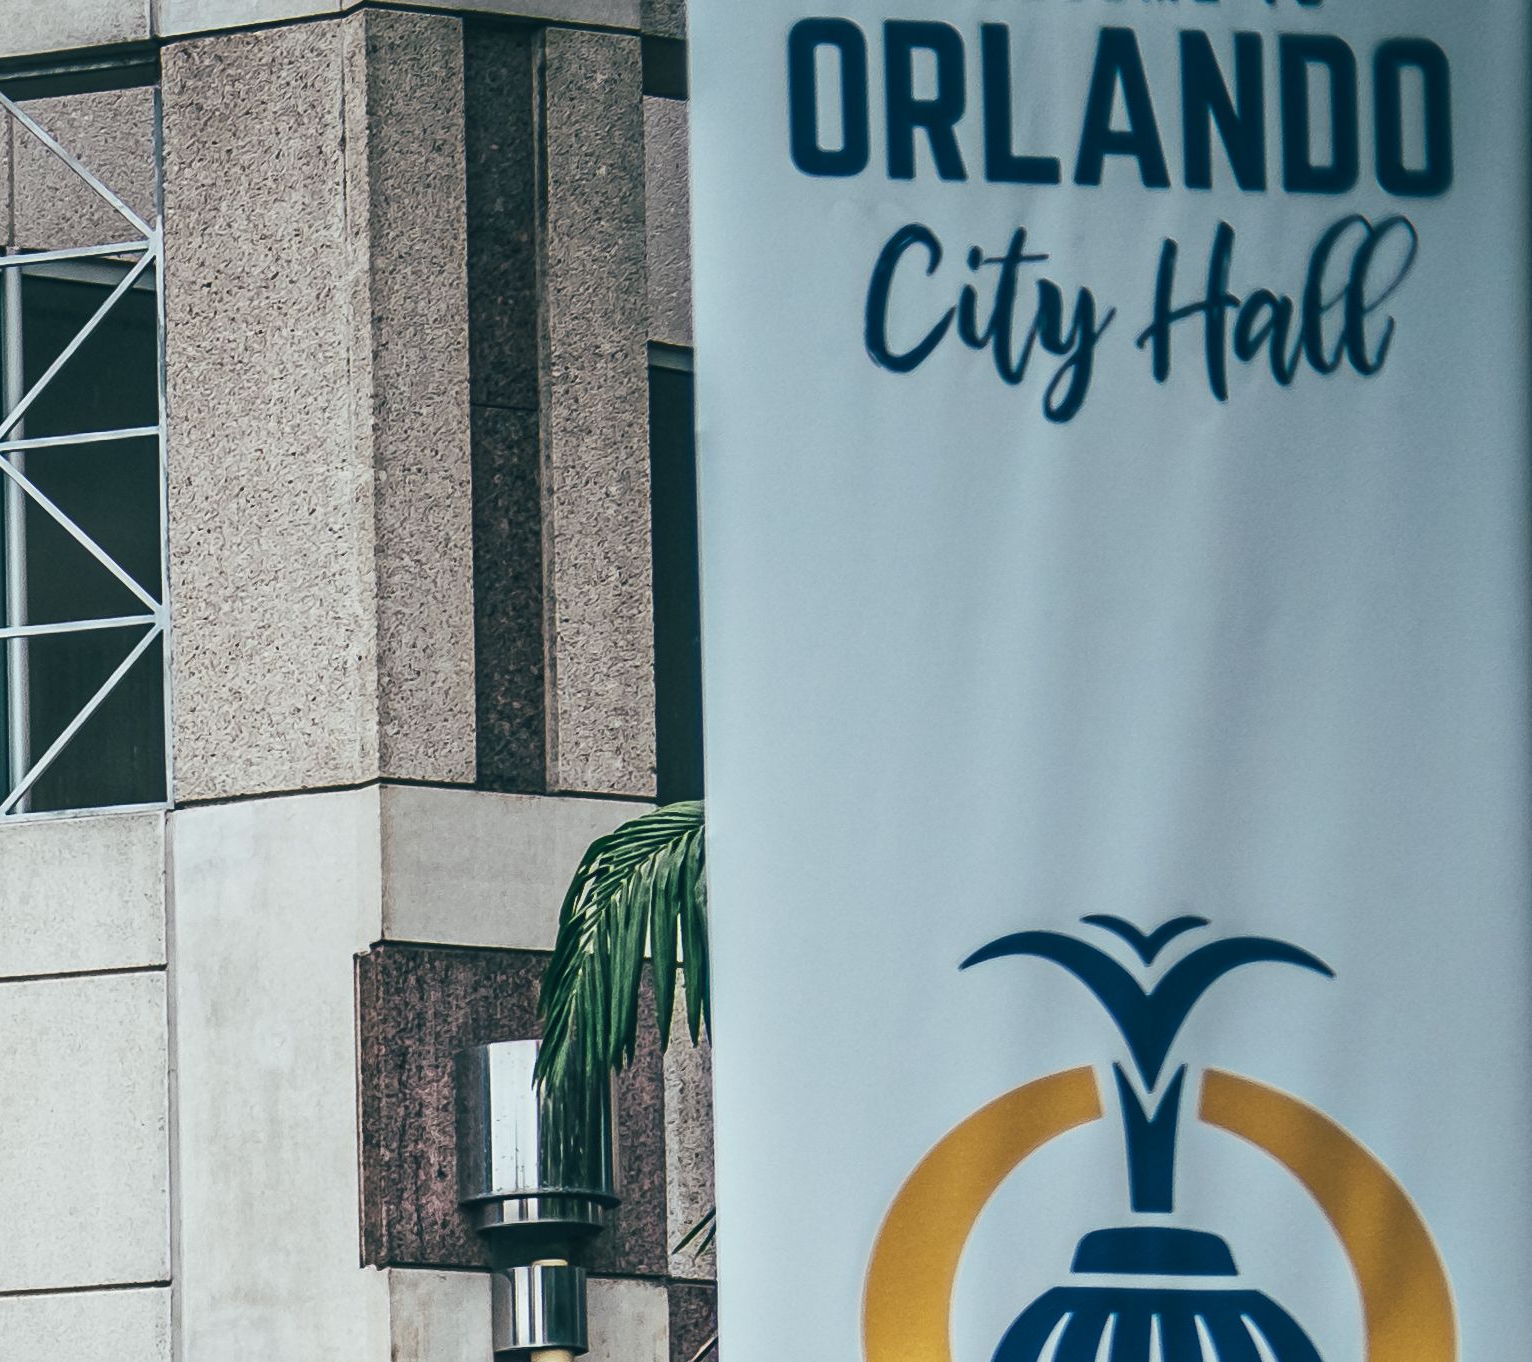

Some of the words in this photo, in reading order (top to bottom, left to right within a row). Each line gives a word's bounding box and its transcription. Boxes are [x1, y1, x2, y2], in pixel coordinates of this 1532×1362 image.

[787, 16, 1455, 198] ORLANDO
[864, 222, 1116, 424] City
[1136, 213, 1419, 401] Hall
